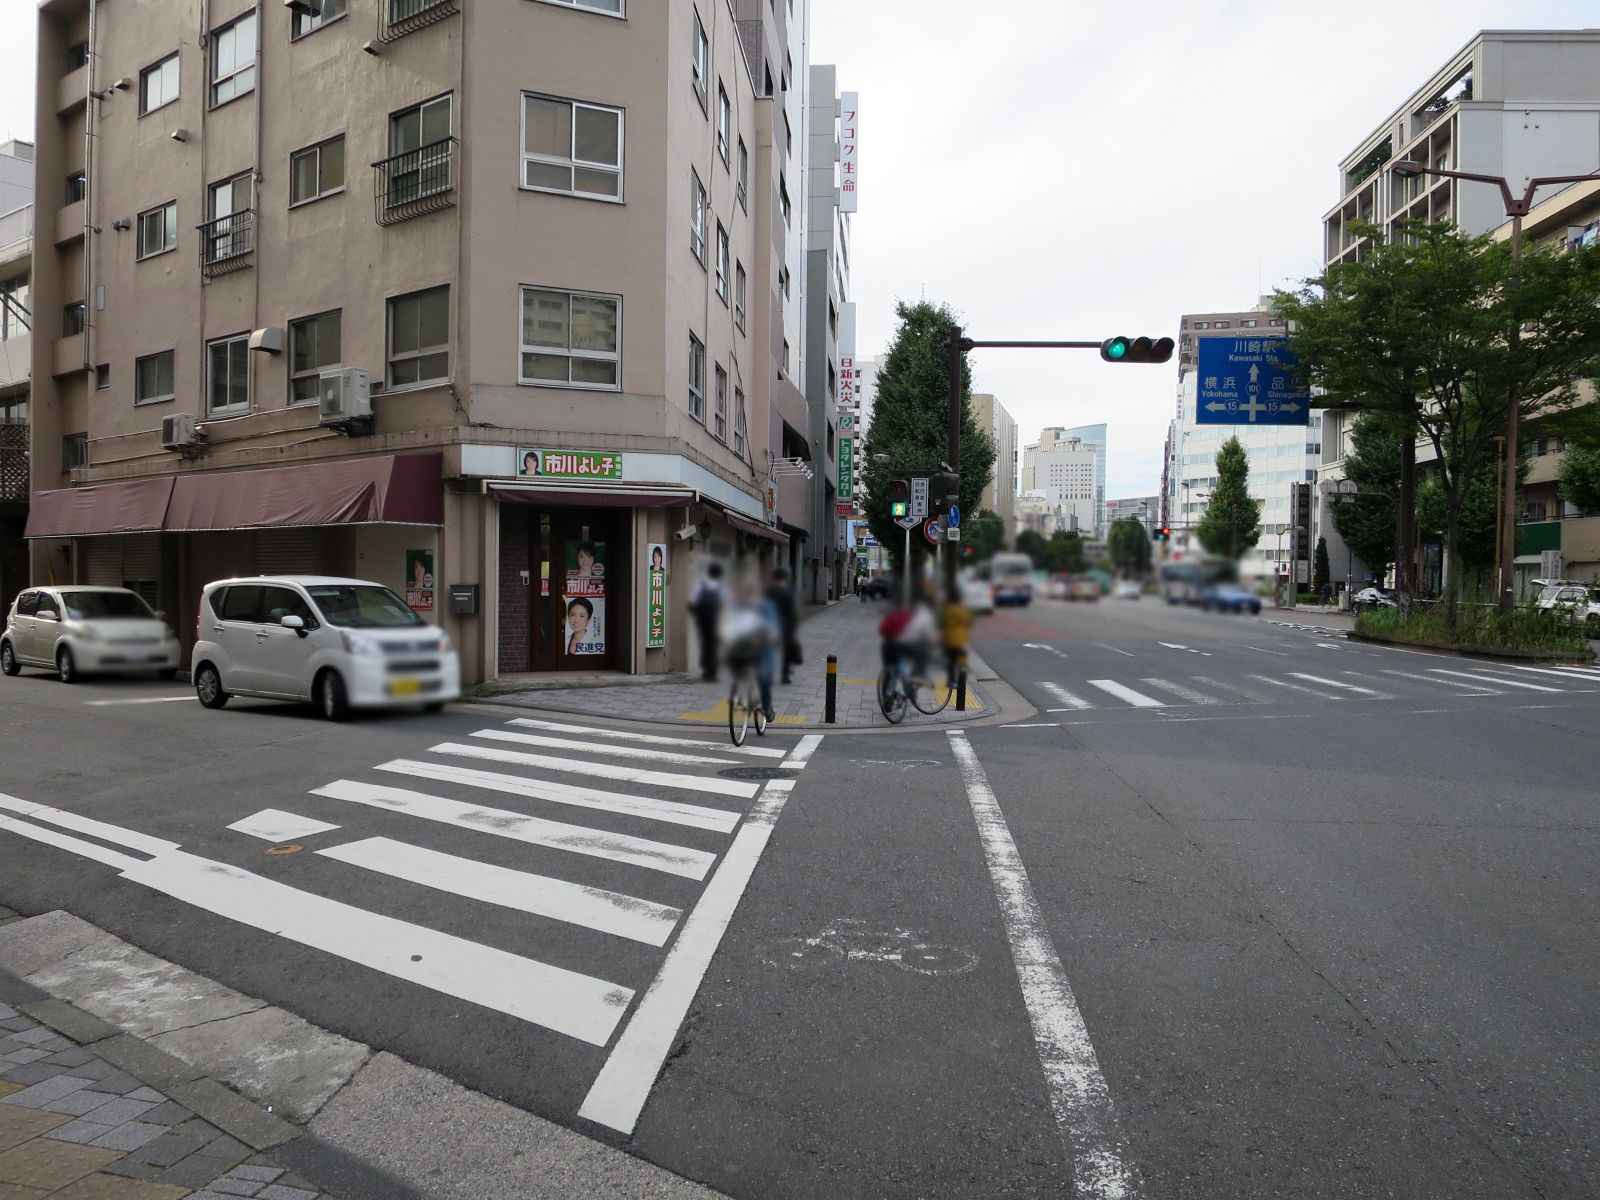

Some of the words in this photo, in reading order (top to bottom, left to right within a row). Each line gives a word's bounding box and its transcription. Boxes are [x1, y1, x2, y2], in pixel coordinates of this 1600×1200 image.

[843, 111, 855, 191] フコク生命
[1234, 340, 1276, 353] 川崎駅
[840, 358, 853, 403] 日新火災
[1204, 376, 1237, 390] 横浜
[1201, 390, 1239, 398] Yokohama
[1248, 385, 1259, 393] 101
[1227, 402, 1237, 411] 15
[1268, 402, 1278, 411] 15
[543, 454, 614, 476] 市川よし子
[840, 440, 850, 497] トヨタレンタカー
[651, 572, 663, 638] 市川よし子
[575, 642, 605, 653] 民進党
